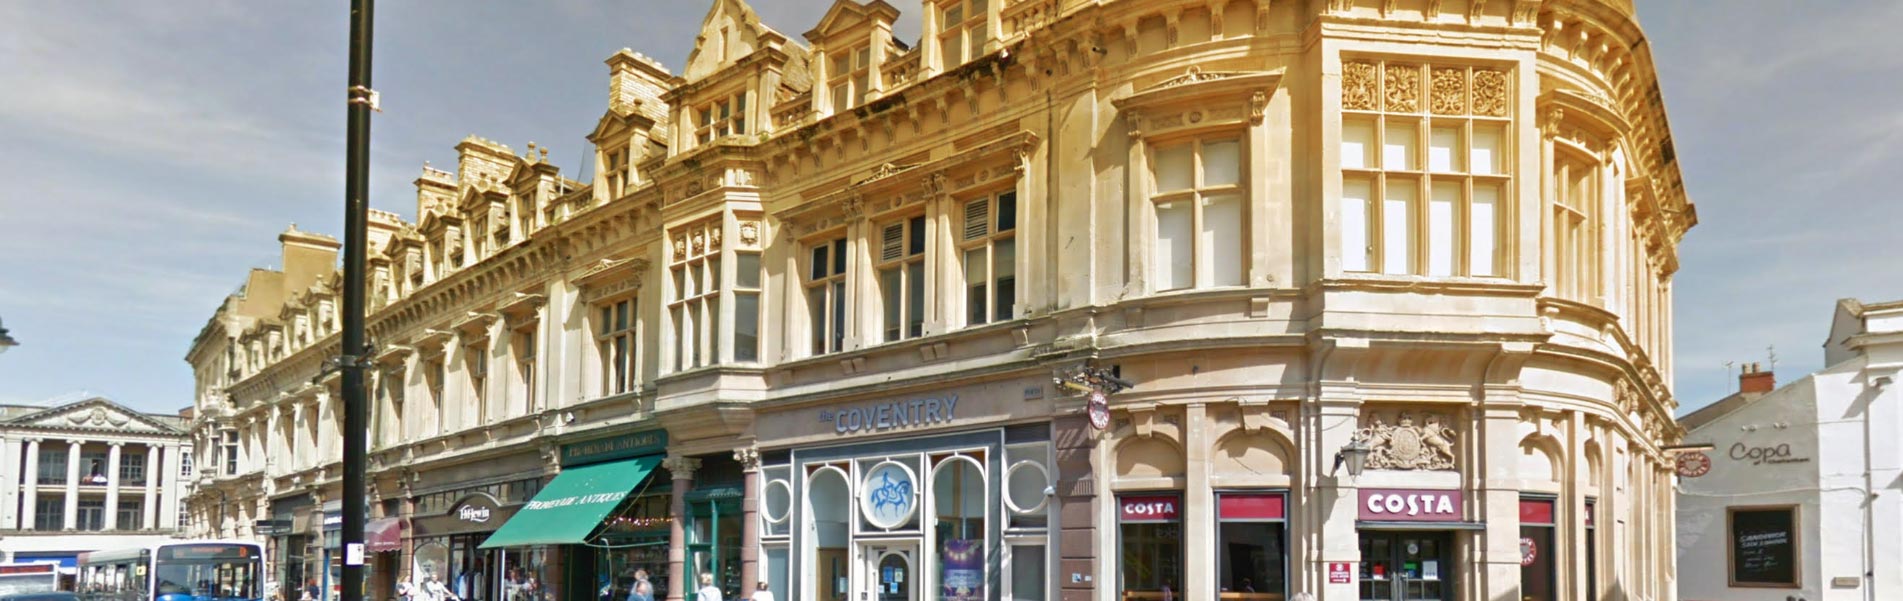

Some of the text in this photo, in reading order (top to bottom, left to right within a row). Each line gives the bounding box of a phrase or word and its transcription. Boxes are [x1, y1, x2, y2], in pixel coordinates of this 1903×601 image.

[818, 393, 959, 433] the COVENTRY
[1729, 442, 1791, 463] Copa
[576, 490, 629, 505] ANTIQUES
[1367, 493, 1454, 516] COSTA
[1125, 502, 1174, 515] COSTA
